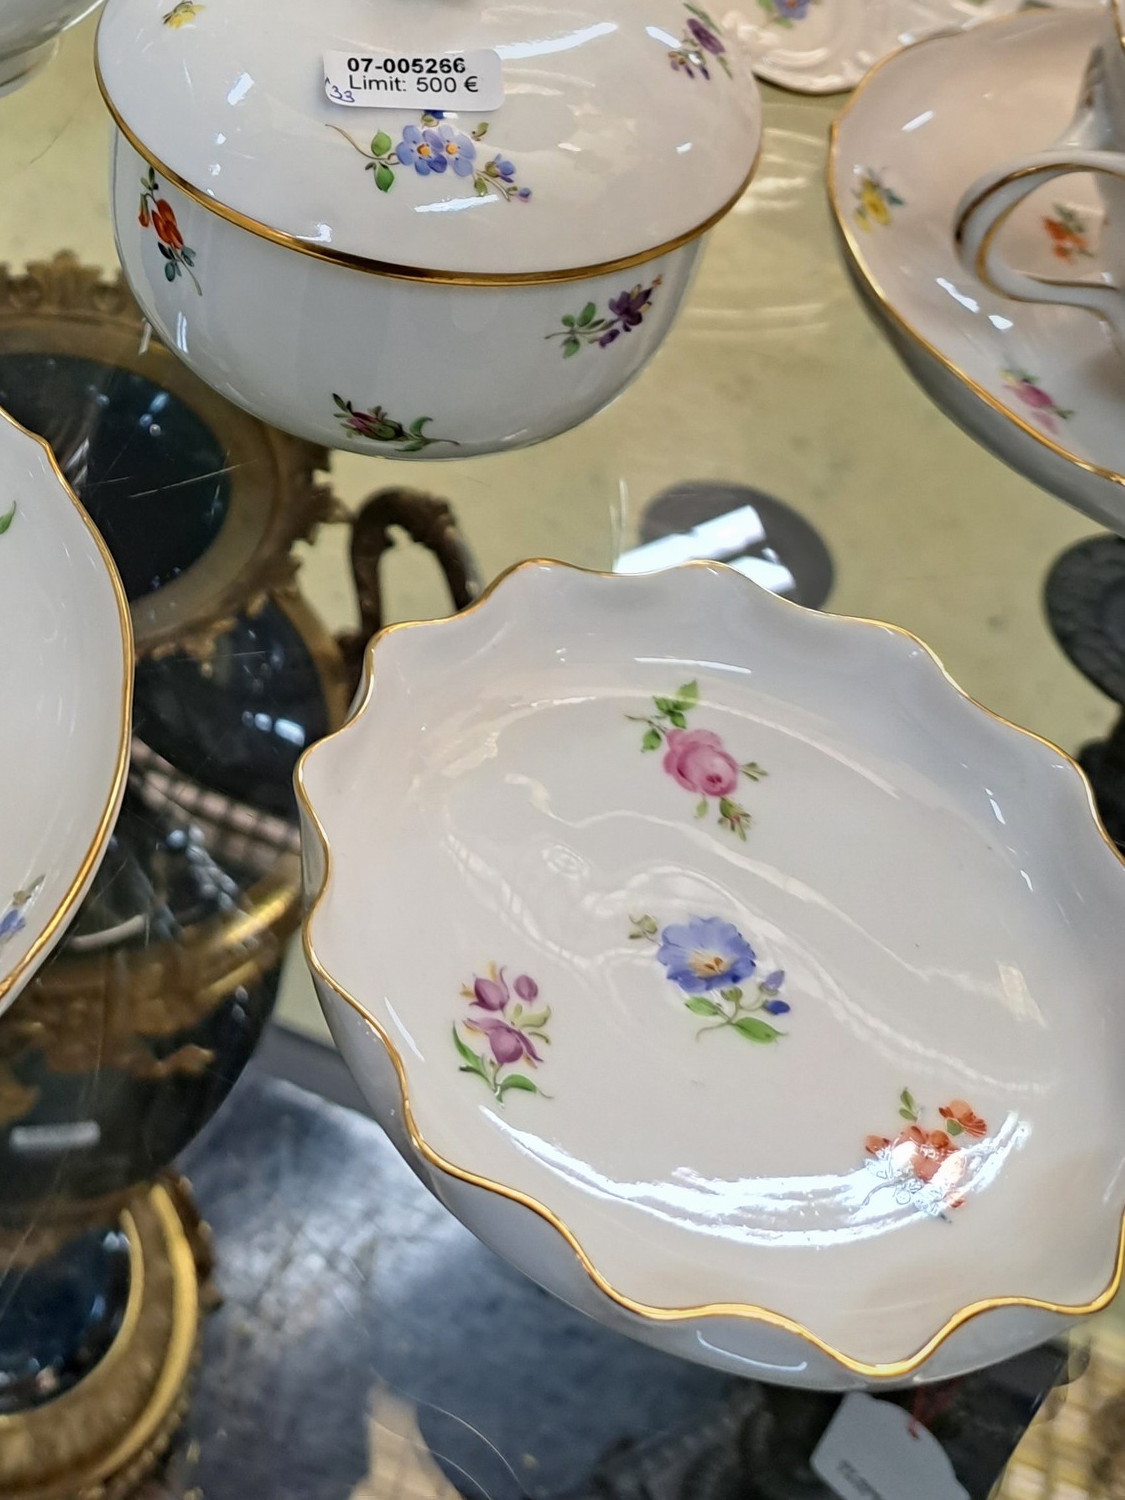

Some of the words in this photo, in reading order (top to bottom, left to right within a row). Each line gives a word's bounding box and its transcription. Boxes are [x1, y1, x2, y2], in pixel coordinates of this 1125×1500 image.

[347, 57, 466, 74] 07-005266
[349, 74, 407, 92] Limit:
[416, 76, 457, 93] 500
[463, 75, 479, 93] €
